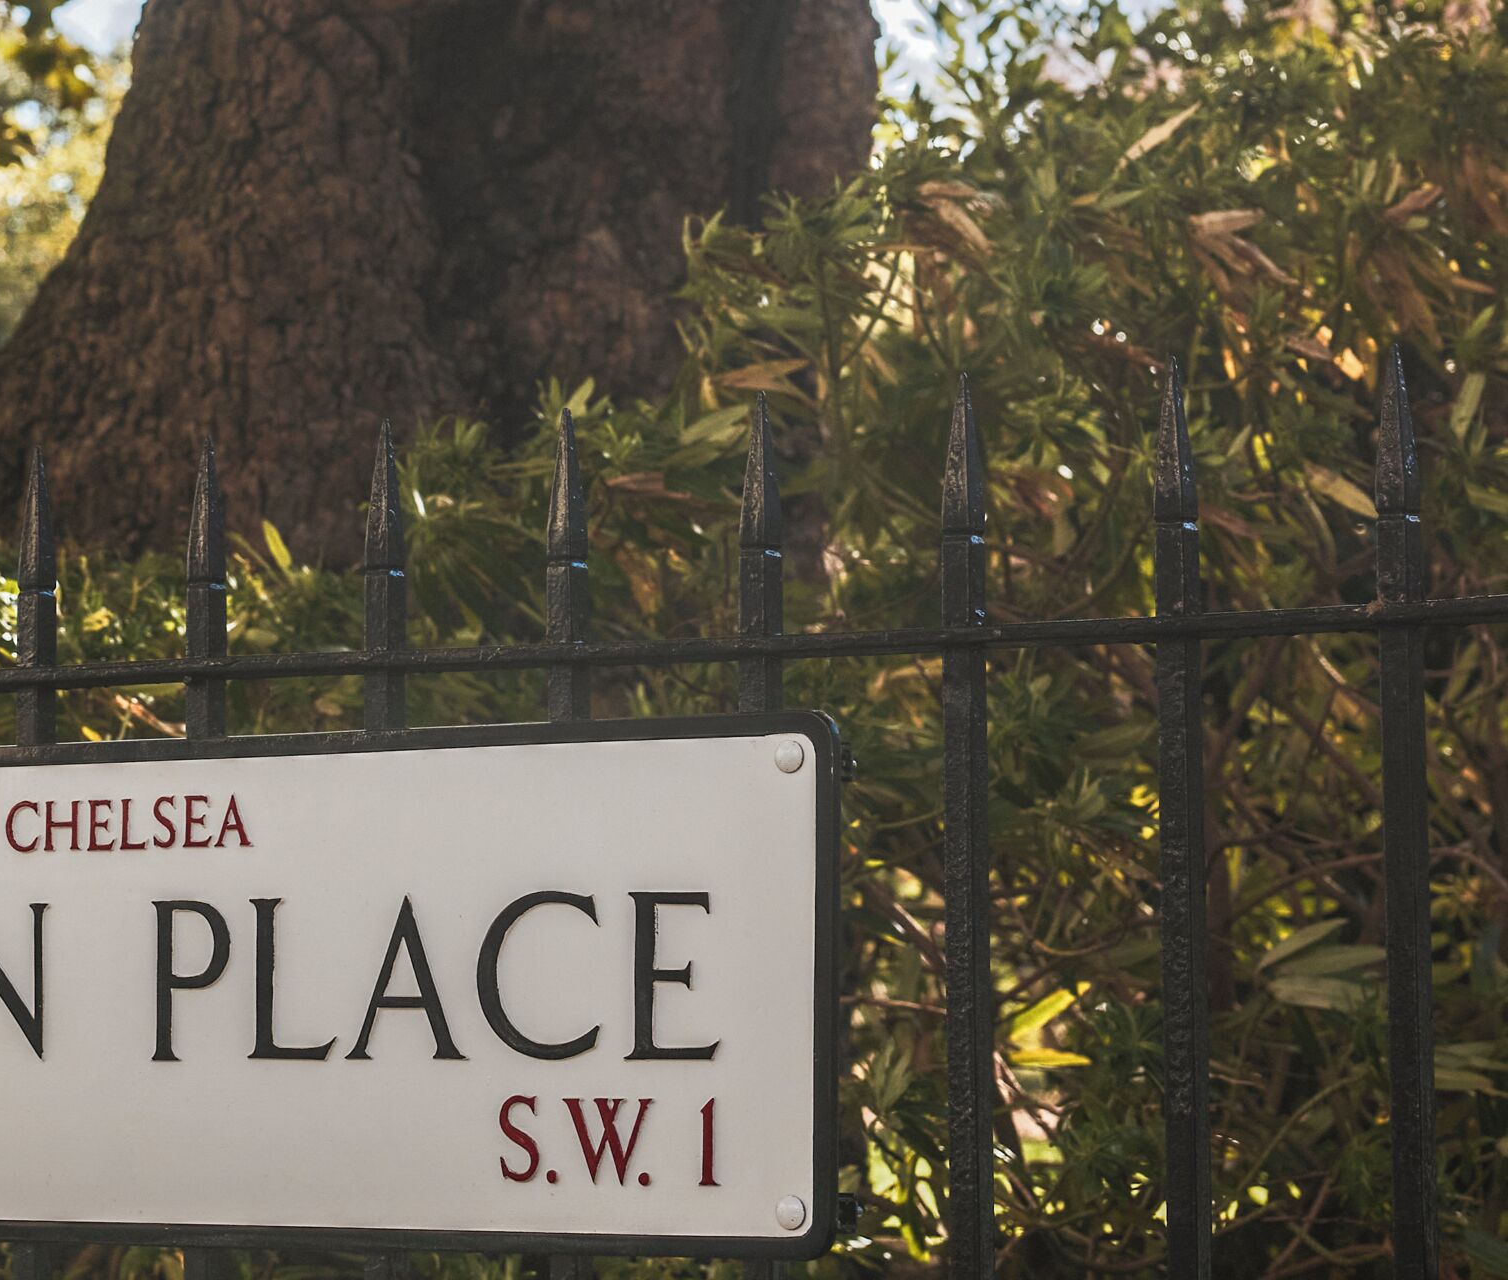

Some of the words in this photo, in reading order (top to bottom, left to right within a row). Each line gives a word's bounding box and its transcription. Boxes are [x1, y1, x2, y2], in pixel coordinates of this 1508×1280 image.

[5, 794, 254, 855] CHELSEA
[150, 890, 722, 1063] PLACE
[498, 1094, 656, 1187] S.W.
[698, 1097, 722, 1188] 1
